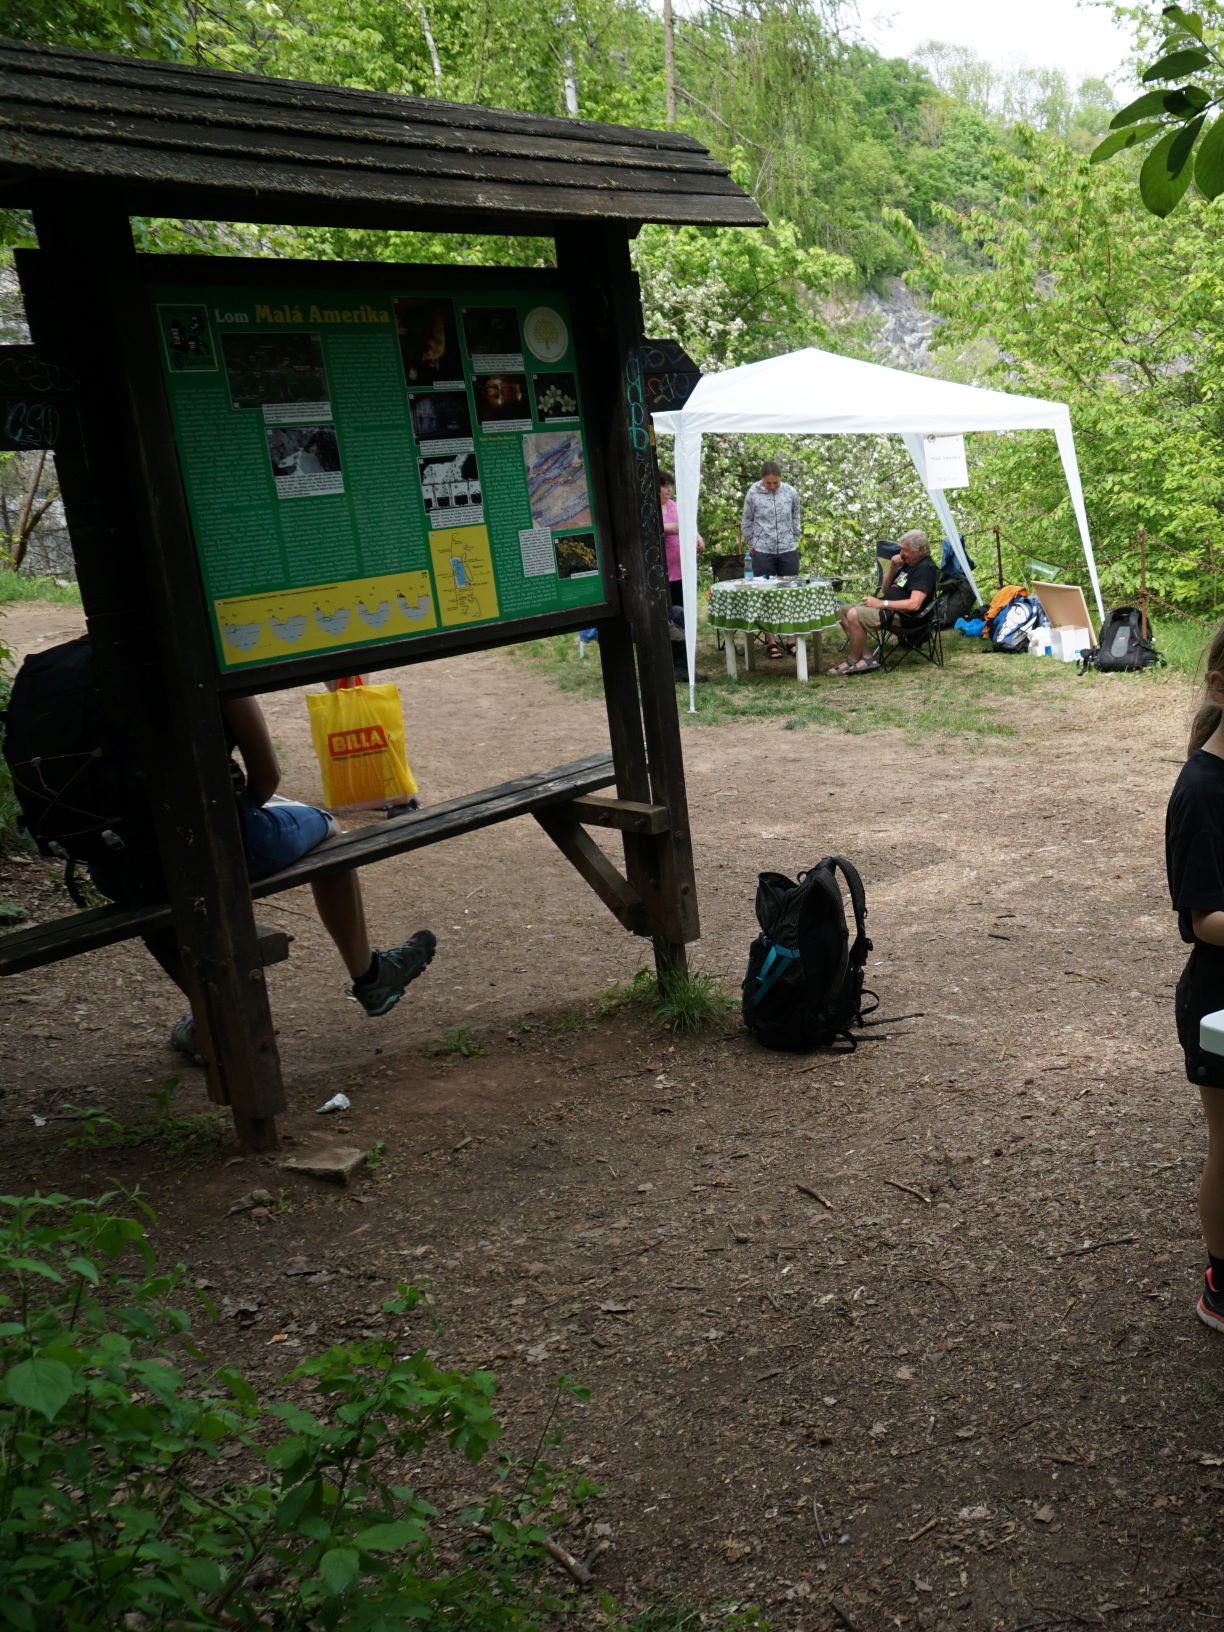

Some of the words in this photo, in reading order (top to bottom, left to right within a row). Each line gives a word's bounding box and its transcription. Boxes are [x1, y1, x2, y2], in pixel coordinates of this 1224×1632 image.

[214, 308, 249, 323] Lom
[255, 303, 304, 324] Malá
[308, 304, 390, 324] Amerika
[331, 729, 384, 753] BILLA
